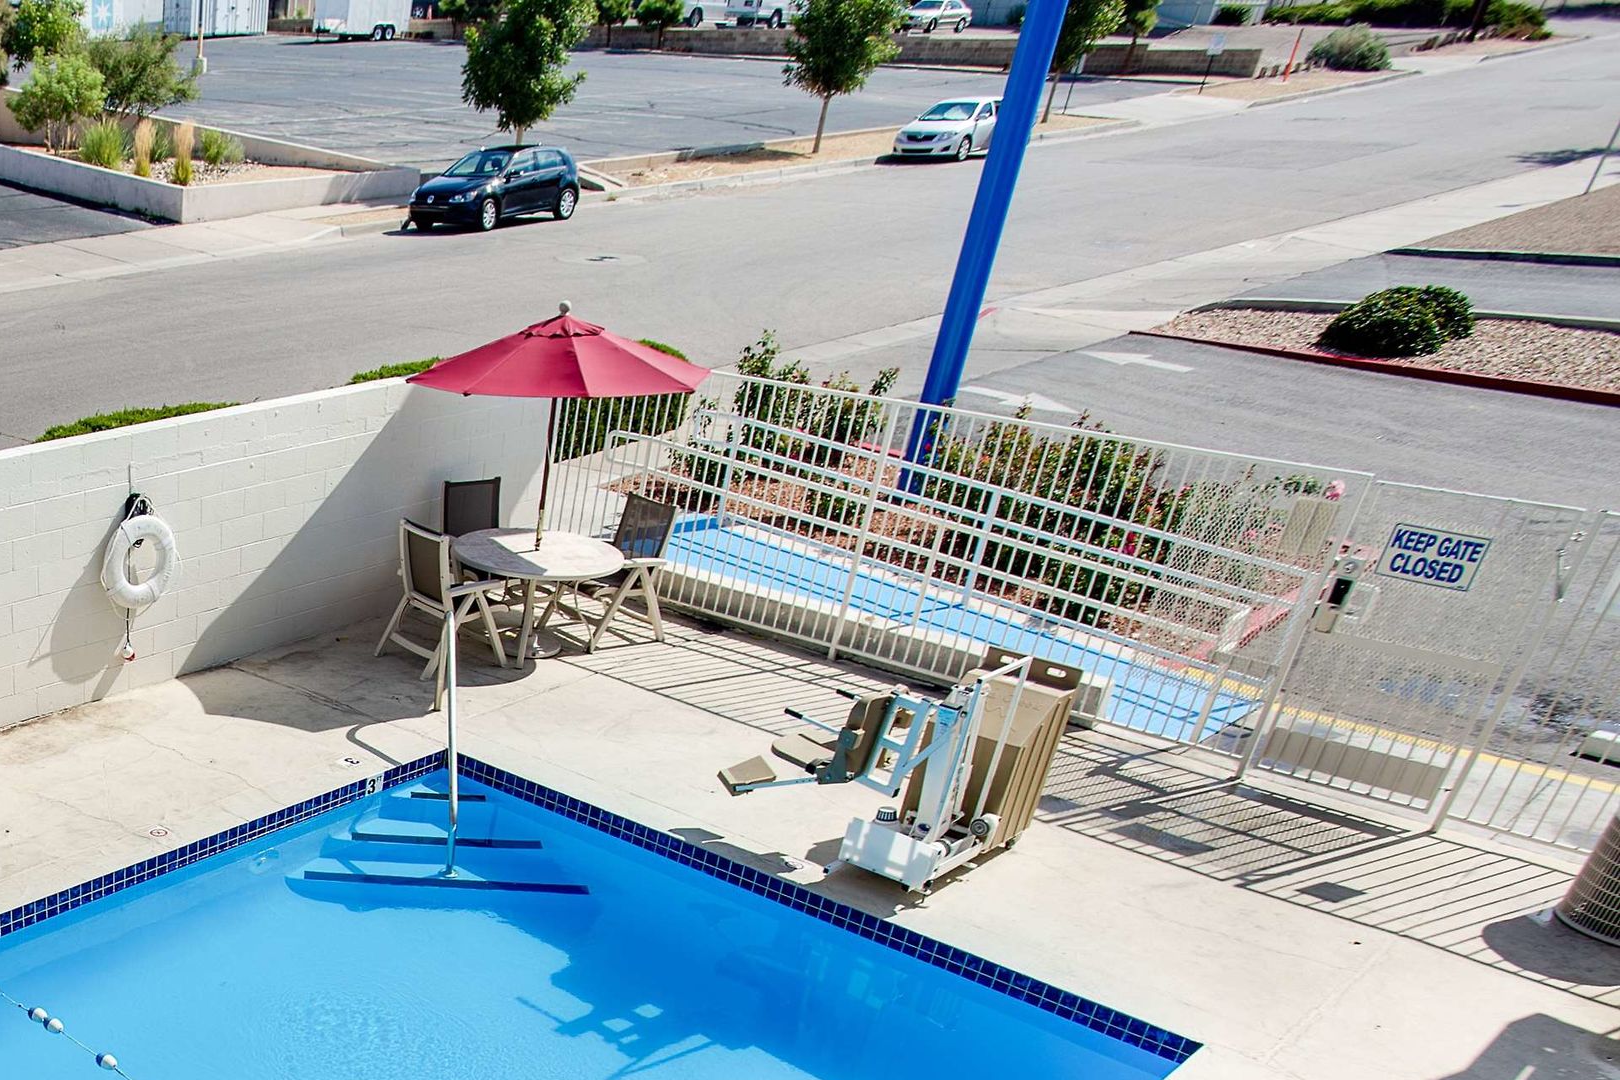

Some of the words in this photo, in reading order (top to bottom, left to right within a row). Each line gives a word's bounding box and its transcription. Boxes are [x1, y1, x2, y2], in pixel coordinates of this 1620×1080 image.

[1390, 529, 1438, 553] KEEP
[1437, 537, 1485, 563] GATE
[1389, 553, 1465, 583] CLOSED
[367, 778, 376, 794] 3
